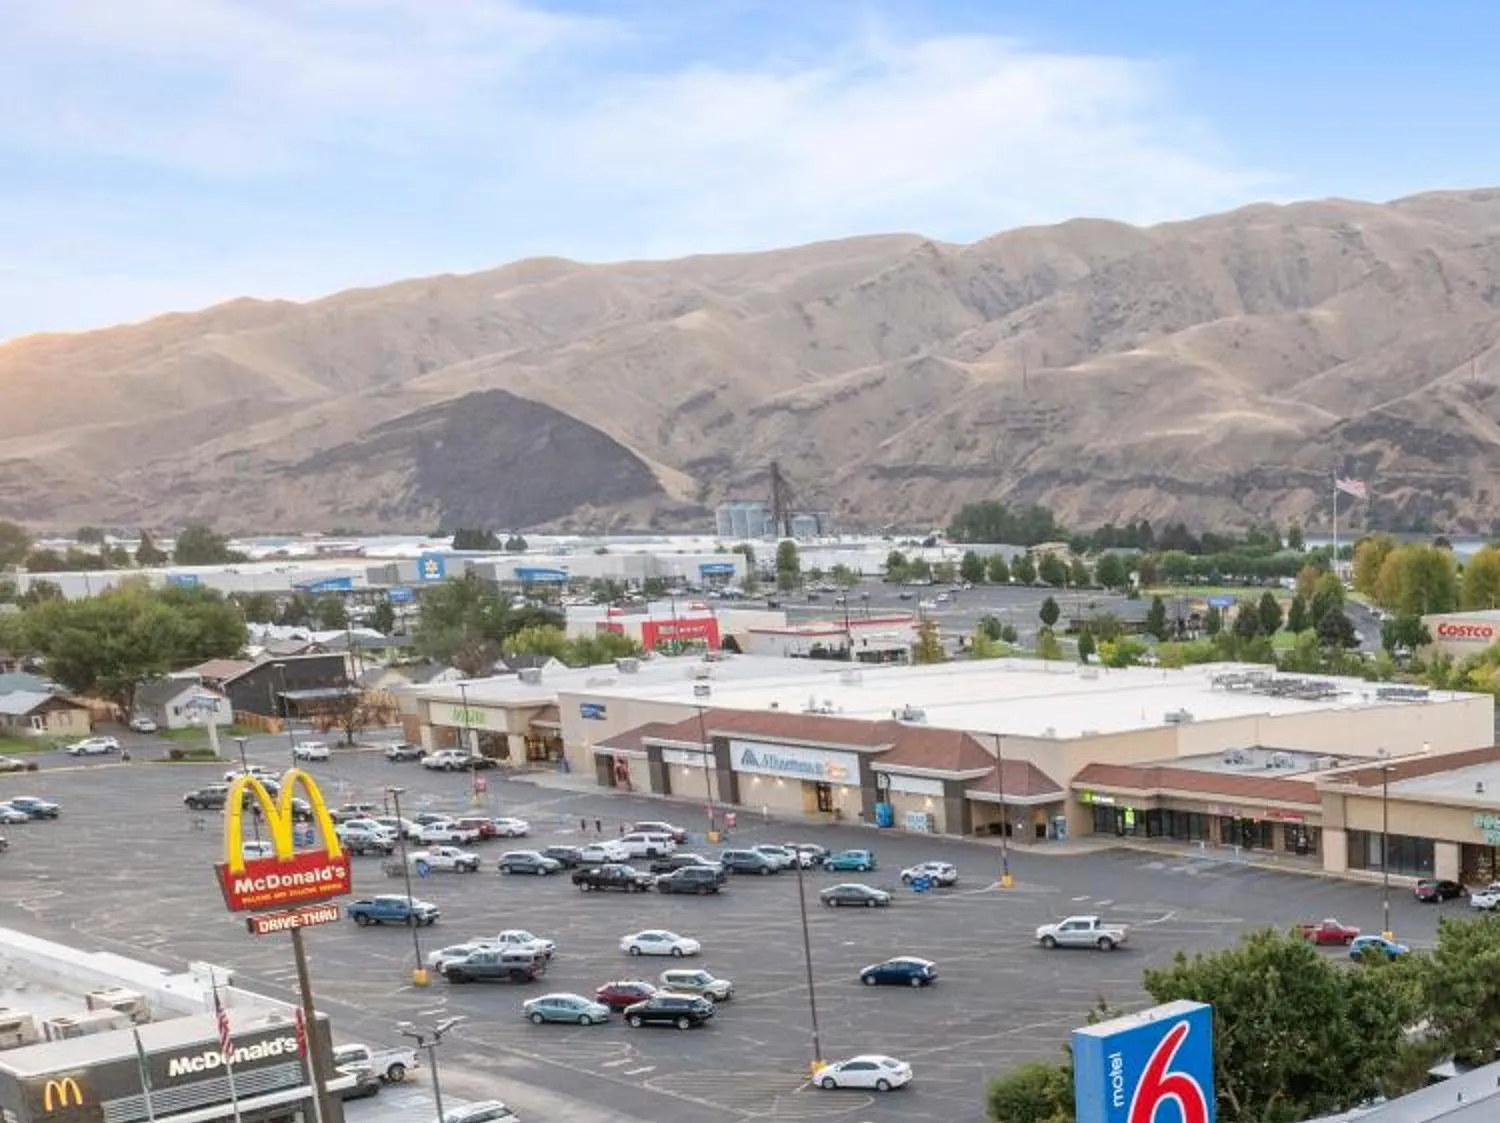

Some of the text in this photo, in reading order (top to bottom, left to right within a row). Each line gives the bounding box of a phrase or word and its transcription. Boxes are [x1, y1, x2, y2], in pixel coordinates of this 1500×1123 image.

[1438, 623, 1493, 637] COSTCO
[234, 865, 346, 894] McDonald's
[1108, 1051, 1125, 1107] motel
